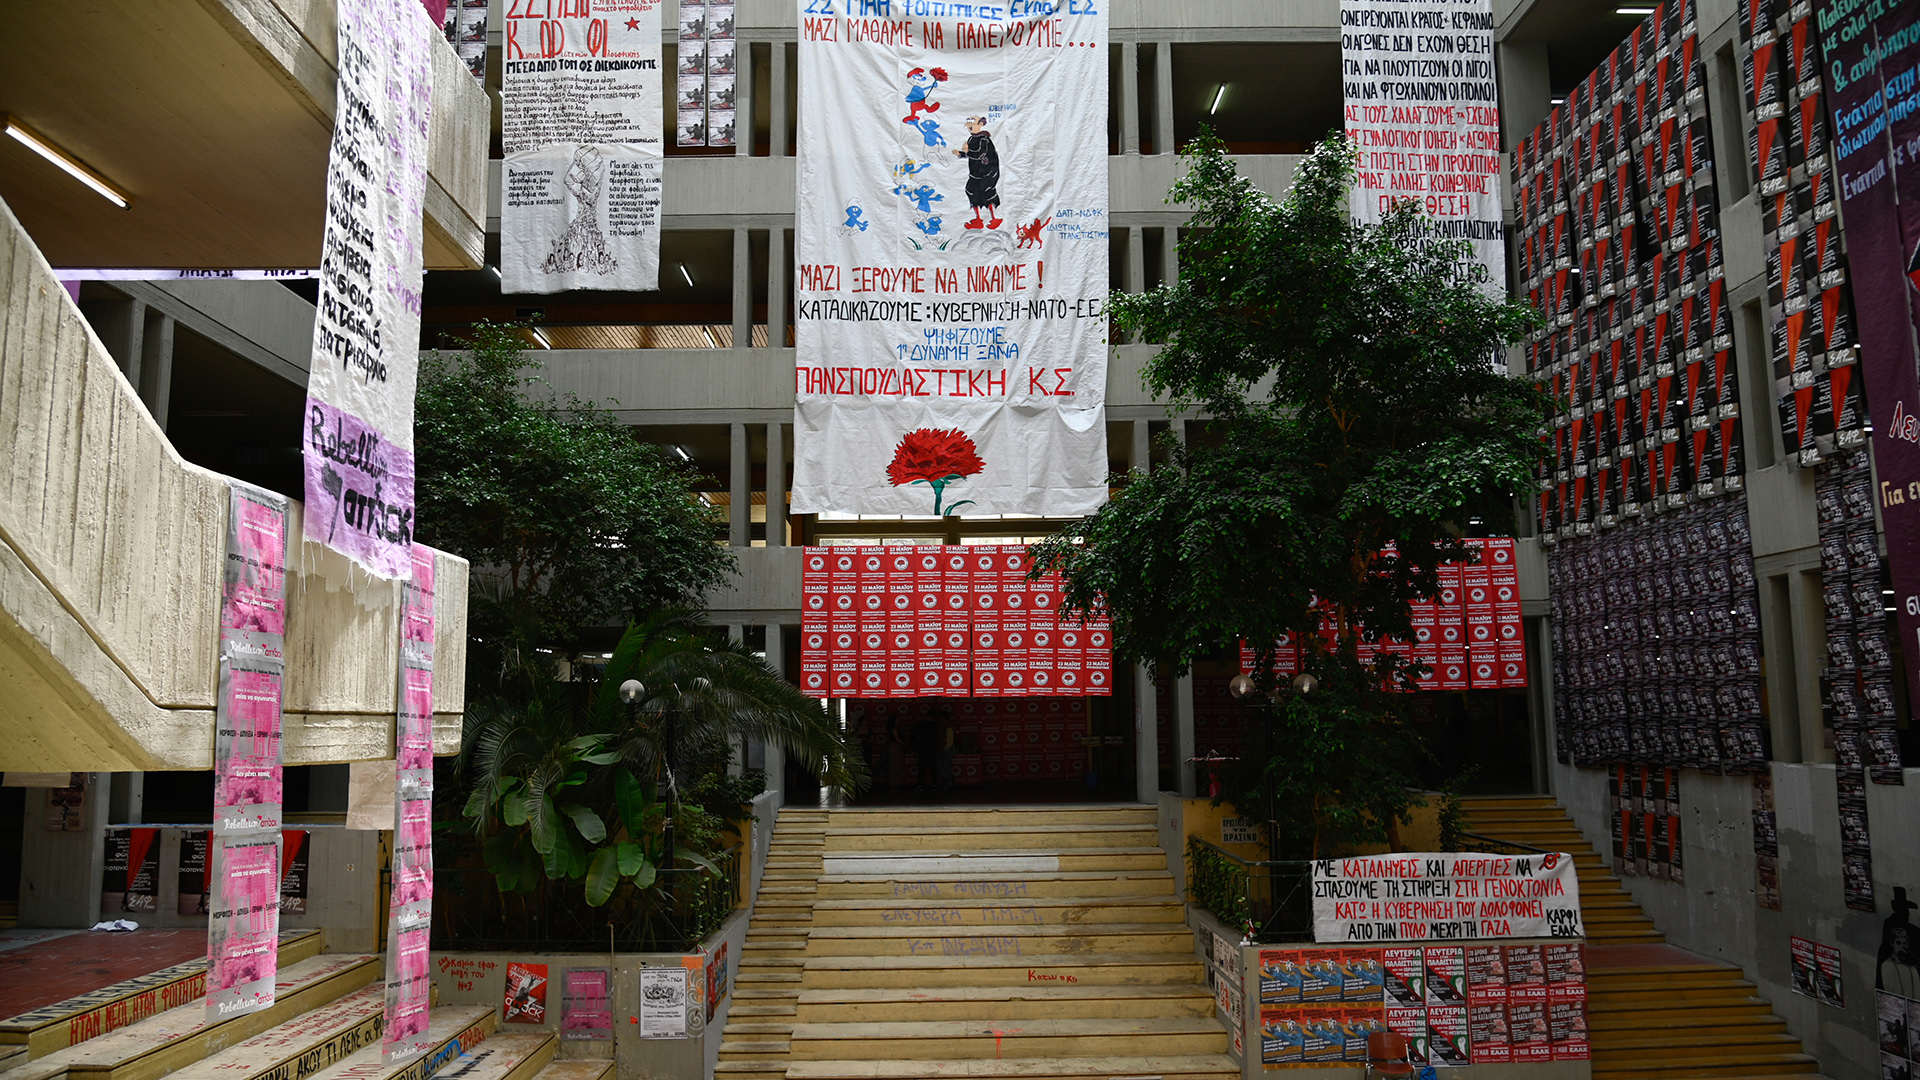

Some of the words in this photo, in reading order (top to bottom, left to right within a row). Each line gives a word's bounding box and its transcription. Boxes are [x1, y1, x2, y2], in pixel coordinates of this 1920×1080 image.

[804, 0, 834, 14] 22
[1341, 10, 1409, 28] ΟΝΕΙΡΕΥΟΝΤΑΙ
[1412, 12, 1444, 29] ΚΡΑΤΟΣ
[1452, 12, 1493, 30] ΚΕΦΑΛΑΙΟ
[804, 17, 838, 42] ΜΑΖΙ
[847, 18, 914, 47] ΜΑΘΑΜΕ
[923, 21, 944, 49] ΝΑ
[1342, 34, 1352, 50] ΟΙ
[1354, 34, 1390, 50] ΑΓΩΝΕΣ
[1394, 36, 1412, 52] ΔΕΝ
[1418, 36, 1453, 53] ΕΧΟΥΝ
[1457, 36, 1490, 53] ΘΕΣΗ
[506, 61, 536, 75] ΜΕΣΑ
[536, 60, 557, 72] ΑΠΟ
[1344, 60, 1361, 76] ΓΙΑ
[1365, 60, 1380, 76] ΝΑ
[1383, 60, 1449, 77] ΠΛΟΥΤΙΖΟΥΝ
[1452, 60, 1462, 77] ΟΙ
[1466, 60, 1492, 79] ΛΙΓΟΙ
[1831, 59, 1849, 93] &
[1345, 82, 1360, 99] ΚΑΙ
[1363, 82, 1378, 99] ΝΑ
[1381, 82, 1447, 100] ΦΤΩΧΑΙΝΟΥΝ
[1450, 82, 1459, 100] ΟΙ
[1461, 82, 1495, 101] ΠΟΛΛΟΙ
[1346, 105, 1359, 121] ΑΣ
[1363, 106, 1388, 123] ΤΟΥΣ
[1391, 106, 1455, 125] ΧΑΛΑΣΟΥΜΕ
[1467, 107, 1499, 126] ΣΧΕΔΙΑ
[1834, 90, 1883, 136] Ενάντια
[1363, 129, 1457, 150] ΣΥΛΛΟΓΙΚΟΠΟΙΗΣΗ
[1467, 131, 1499, 151] ΑΓΩΝΕΣ
[1371, 152, 1405, 171] ΠΙΣΤΗ
[1409, 153, 1439, 171] ΣΤΗΝ
[1443, 153, 1499, 174] ΠΡΟΟΠΤΙΚΗ
[1358, 173, 1384, 189] ΜΙΑΣ
[1391, 173, 1427, 190] ΑΛΛΗΣ
[1430, 174, 1489, 194] ΚΟΙΝΩΝΙΑΣ
[1841, 158, 1886, 201] Ενάντια
[1426, 195, 1469, 215] ΘΕΣΗ
[1046, 222, 1082, 232] ΙΔΙΩΤΙΚΑ
[801, 265, 840, 291] ΜΑΖΙ
[852, 267, 925, 292] ΞΕΡΟΥΜΕ
[935, 268, 958, 293] ΝΑ
[967, 264, 1027, 292] ΝΙΚΑΜΕ
[911, 345, 969, 361] ΔΥΝΑΜΗ
[977, 344, 1019, 360] ΞΑΝΑ
[796, 366, 1006, 396] ΠΑΝΣΠΟΥΔΑΣΤΙΚΗ
[1881, 481, 1905, 508] Για
[1224, 833, 1257, 841] ΠΡΑΣΙΝΟ
[1314, 860, 1336, 877] ΜΕ
[1343, 859, 1422, 878] ΚΑΤΑΛΗΨΕΙΣ
[1426, 859, 1445, 877] ΚΑΙ
[1451, 858, 1512, 877] ΑΠΕΡΓΙΕΣ
[1515, 859, 1533, 877] ΝΑ
[892, 880, 940, 897] ΚΑΜΙΑ
[1315, 880, 1378, 898] ΣΠΑΣΟΥΜΕ
[1383, 880, 1399, 898] ΤΗ
[1402, 879, 1450, 897] ΣΤΗΡΙΞΗ
[1455, 879, 1478, 897] ΣΤΗ
[1484, 878, 1564, 897] ΓΕΝΟΚΤΟΝΙΑ
[1335, 902, 1368, 919] ΚΑΤΩ
[1372, 902, 1380, 918] Η
[1384, 901, 1451, 919] ΚΥΒΕΡΝΗΣΗ
[1457, 901, 1476, 918] ΠΟΥ
[1480, 900, 1544, 918] ΔΟΛΟΦΟΝΕΙ
[1546, 909, 1577, 925] ΚΑΡΦΙ
[1349, 922, 1373, 940] ΑΠΟ
[1377, 922, 1396, 939] ΤΗΝ
[1400, 922, 1426, 938] ΠΥΛΟ
[1430, 921, 1461, 938] ΜΕΧΡΙ
[1462, 921, 1477, 937] ΤΗ
[1481, 920, 1511, 936] ΓΑΖΑ
[1551, 923, 1579, 937] ΕΑΑΚ
[1385, 949, 1421, 957] ΛΕΥΤΕΡΙΑ
[1427, 948, 1462, 956] ΛΕΥΤΕΡΙΑ
[70, 1010, 100, 1046] ΗΤΑΝ
[133, 991, 156, 1020] ΗΤΑΝ
[162, 973, 207, 1011] ΦΟΙΤΗΤΕΣ
[1430, 1008, 1466, 1016] ΛΕΥΤΕΡΙΑ
